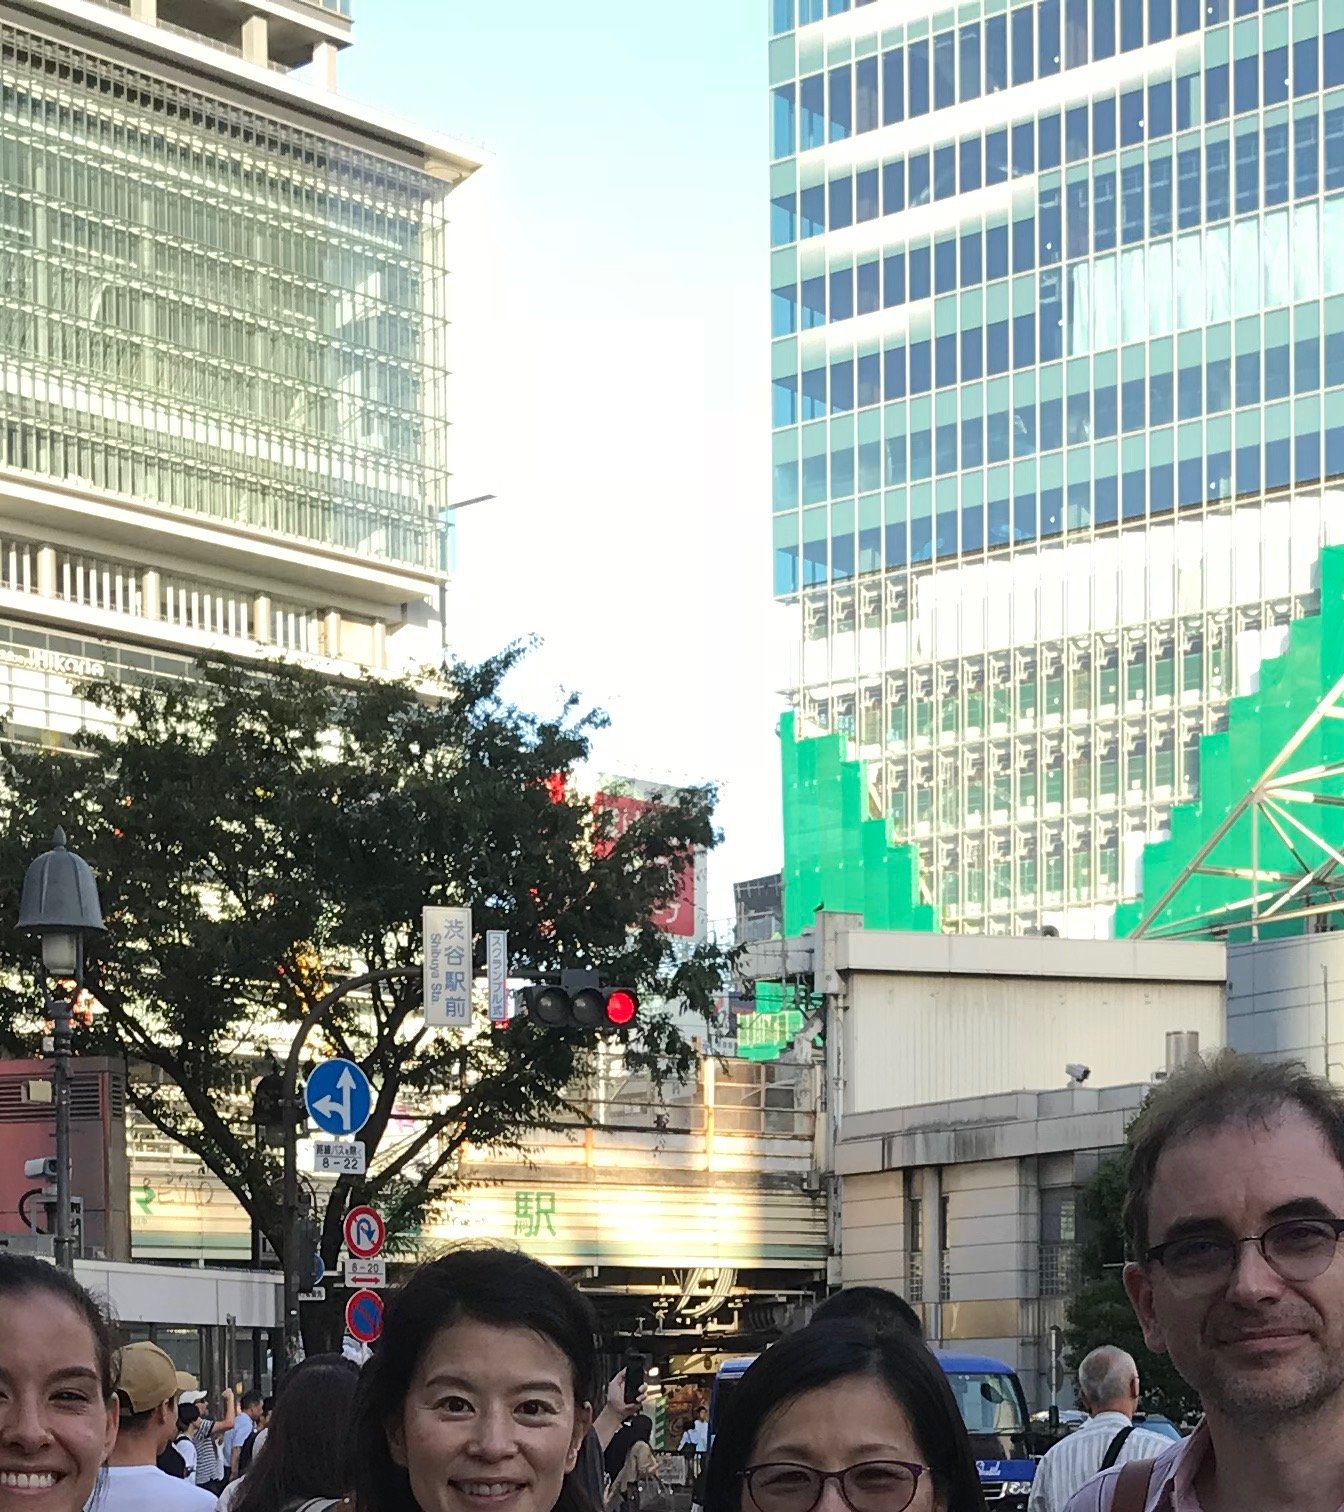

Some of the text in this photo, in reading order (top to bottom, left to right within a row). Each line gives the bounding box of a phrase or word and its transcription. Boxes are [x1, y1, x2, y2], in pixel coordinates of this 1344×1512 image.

[429, 932, 442, 979] Shibuya
[444, 918, 466, 1018] 渋谷駅前
[513, 1191, 557, 1237] 駅
